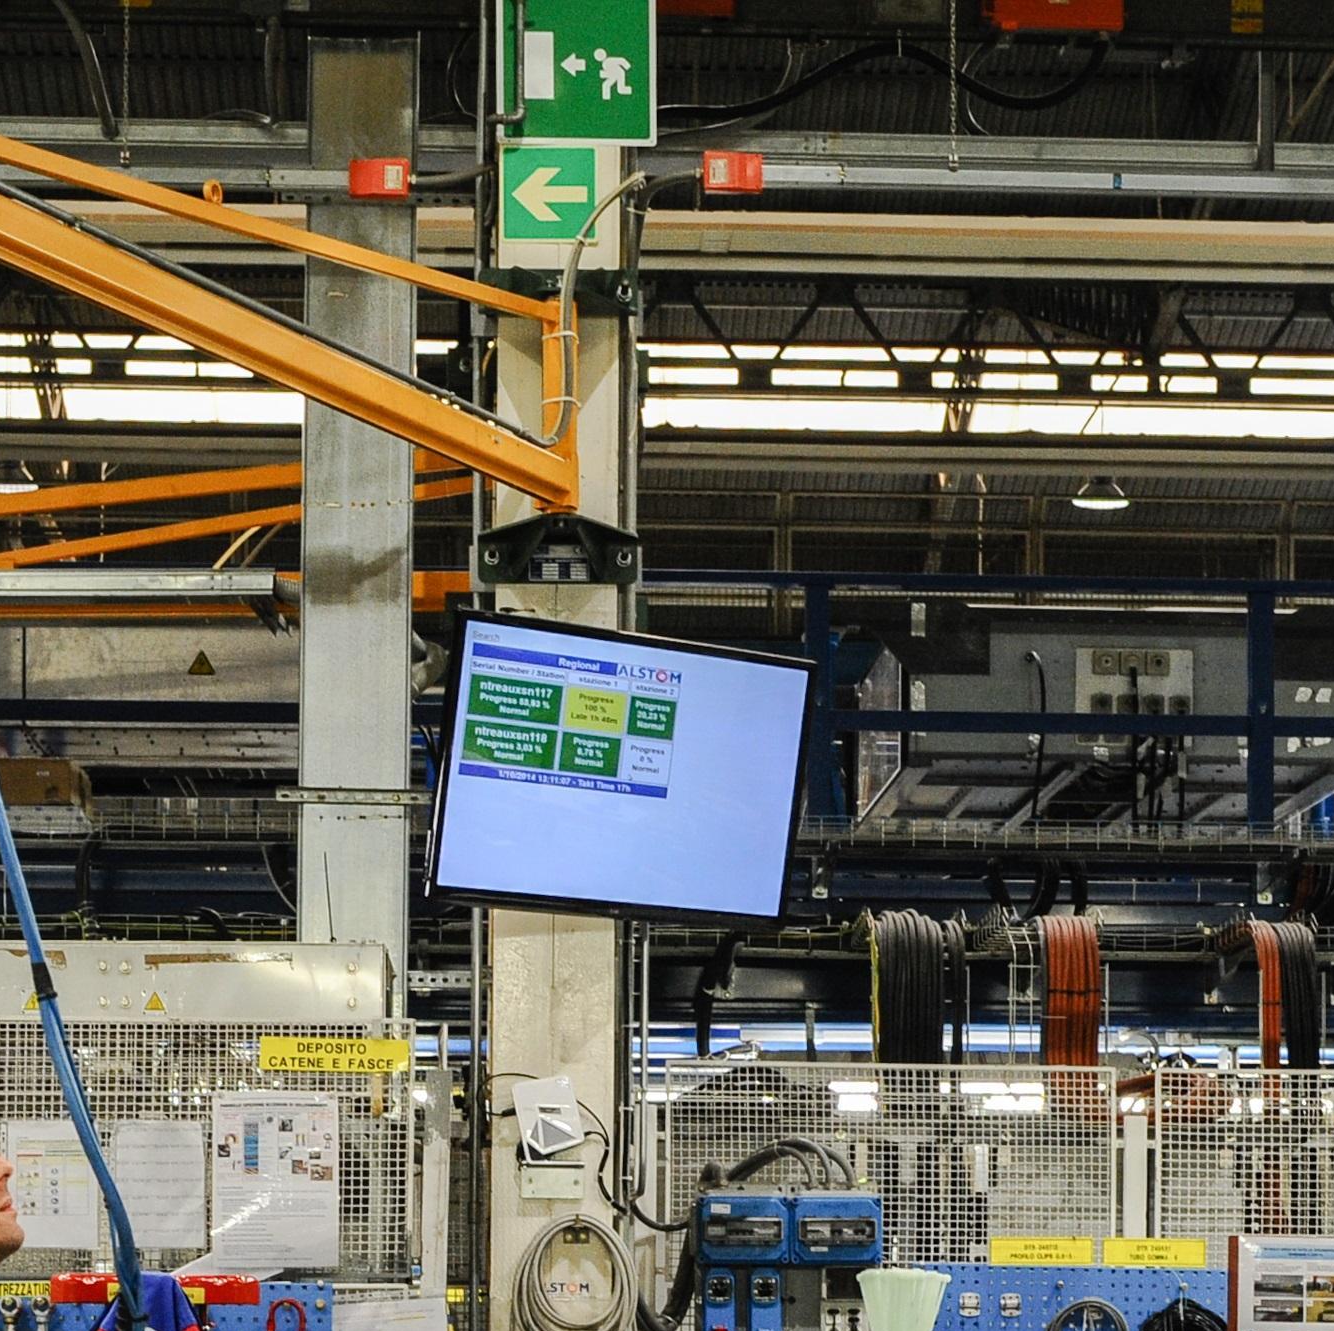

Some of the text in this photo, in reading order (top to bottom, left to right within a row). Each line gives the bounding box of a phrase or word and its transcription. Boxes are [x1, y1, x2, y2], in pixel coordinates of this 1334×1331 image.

[558, 657, 600, 672] Regional
[618, 664, 682, 684] ALSTOM
[480, 692, 517, 707] Progress
[579, 692, 614, 705] Progress
[499, 704, 530, 716] Normal
[635, 699, 671, 713] Progress
[637, 720, 665, 732] Normal
[477, 738, 513, 752] Progress
[573, 737, 609, 751] Progress
[631, 744, 665, 757] Progress
[494, 750, 524, 762] Normal
[574, 756, 604, 768] Normal
[632, 765, 660, 774] Normal
[297, 1042, 367, 1055] DEPOSITO
[268, 1056, 394, 1070] CATENE E FASCE
